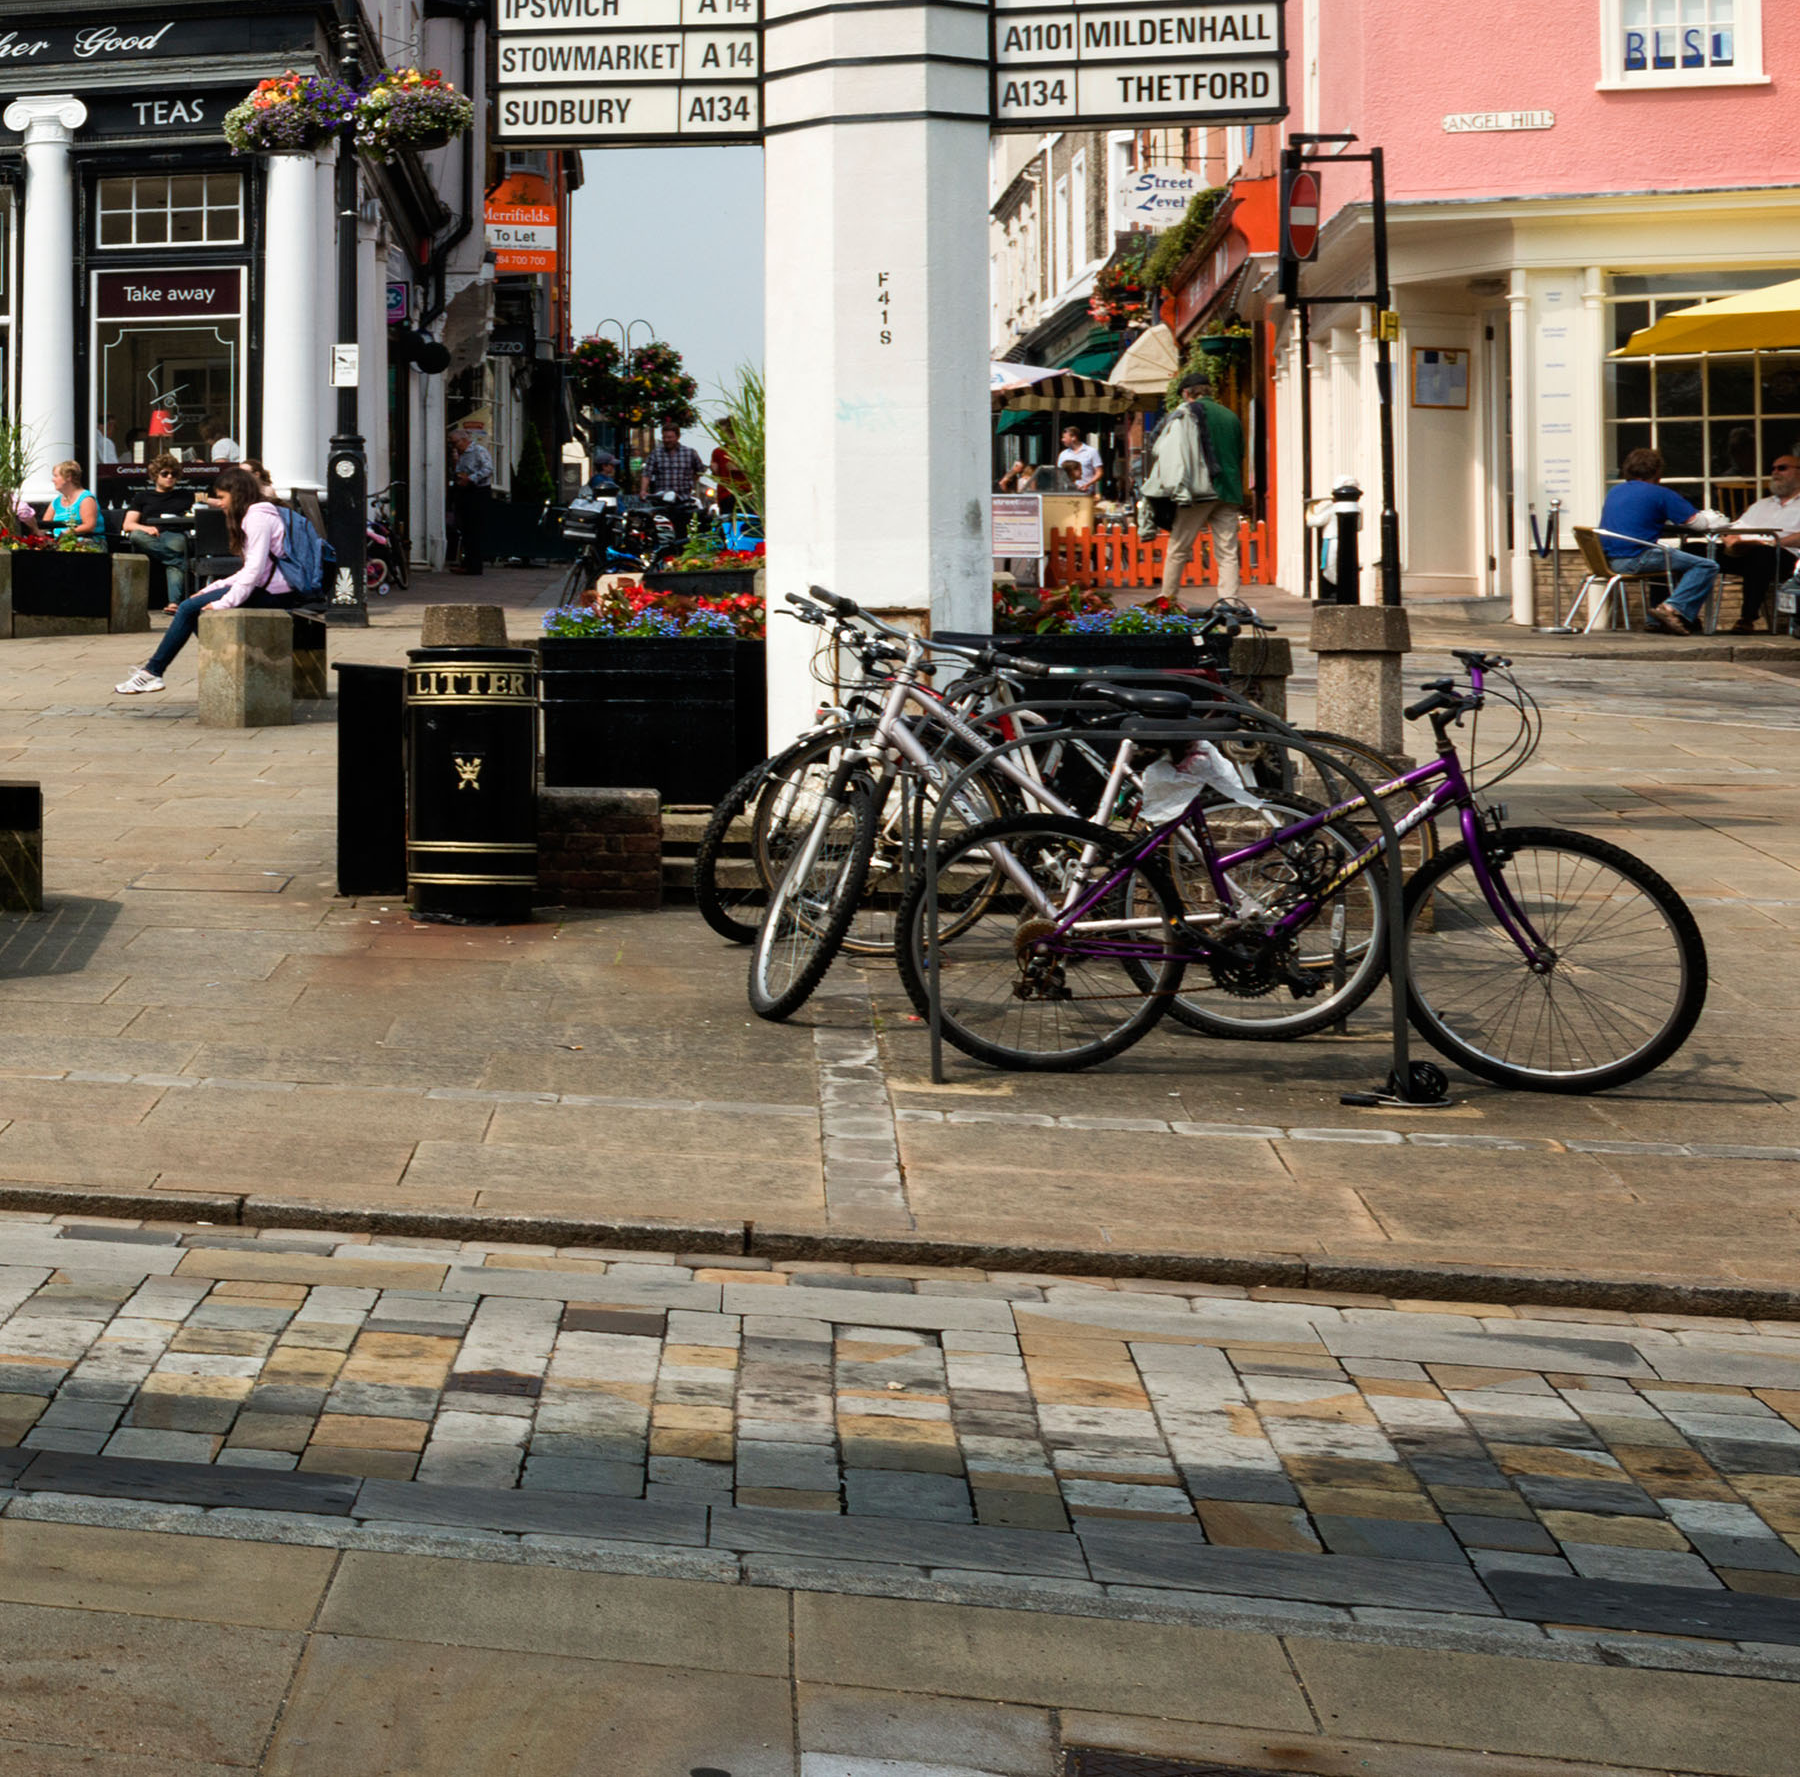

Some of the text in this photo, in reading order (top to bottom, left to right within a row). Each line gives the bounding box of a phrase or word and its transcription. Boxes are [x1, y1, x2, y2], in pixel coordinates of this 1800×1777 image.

[73, 22, 175, 58] Good
[1002, 14, 1271, 53] A1101 MILDENHALL
[502, 43, 680, 73] STOWMARKET
[1000, 71, 1270, 108] A134 THETFORD
[132, 98, 204, 126] TEAS
[504, 95, 751, 126] SUDBURY A134
[1449, 112, 1548, 129] ANGEL HILL
[1135, 174, 1193, 191] Street
[1136, 194, 1185, 211] Level
[483, 207, 550, 222] Merrifields
[494, 229, 536, 242] To Let
[123, 285, 216, 305] Take away
[116, 466, 220, 474] Genuine comments
[416, 672, 526, 695] LITTER
